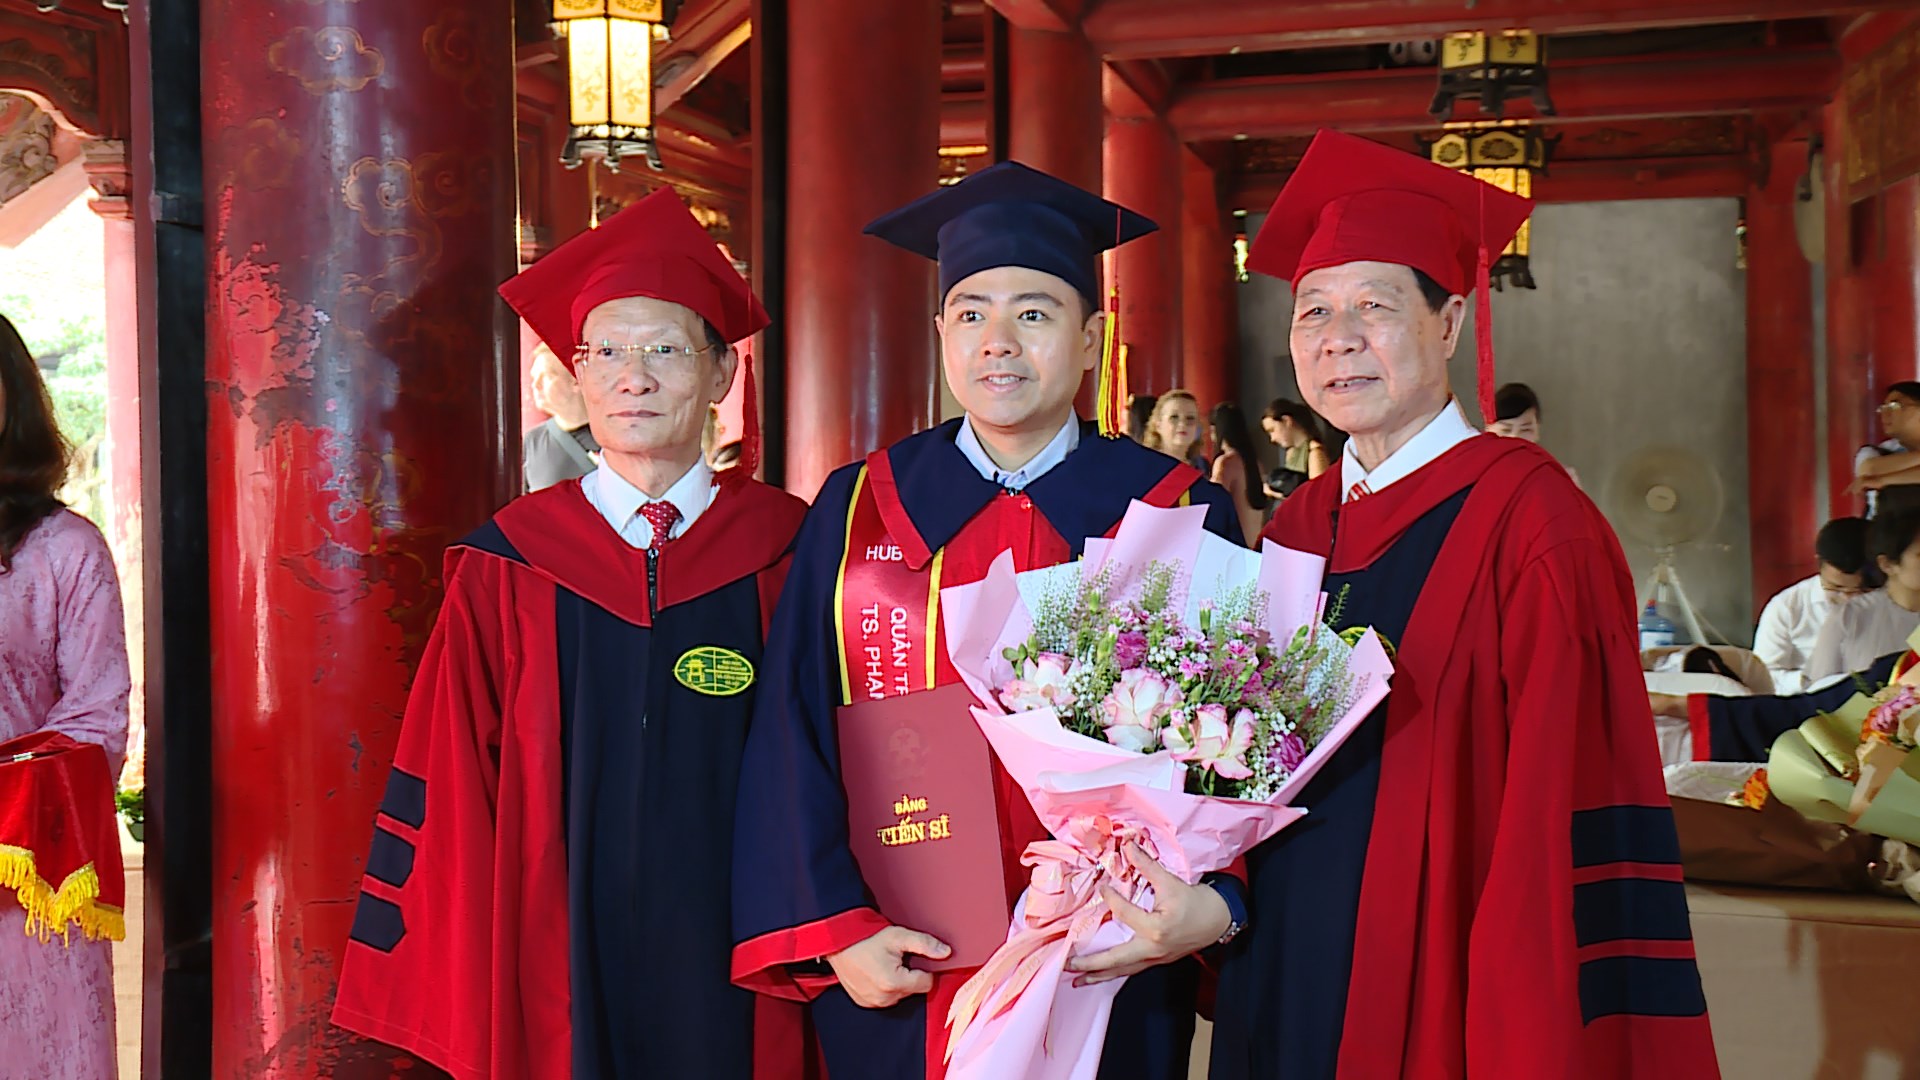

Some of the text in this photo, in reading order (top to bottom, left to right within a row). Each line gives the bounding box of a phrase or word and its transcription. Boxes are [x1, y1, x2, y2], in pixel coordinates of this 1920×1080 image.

[861, 603, 879, 640] TS.
[890, 607, 912, 667] QUẢN
[877, 814, 951, 846] TIẾN SĨ
